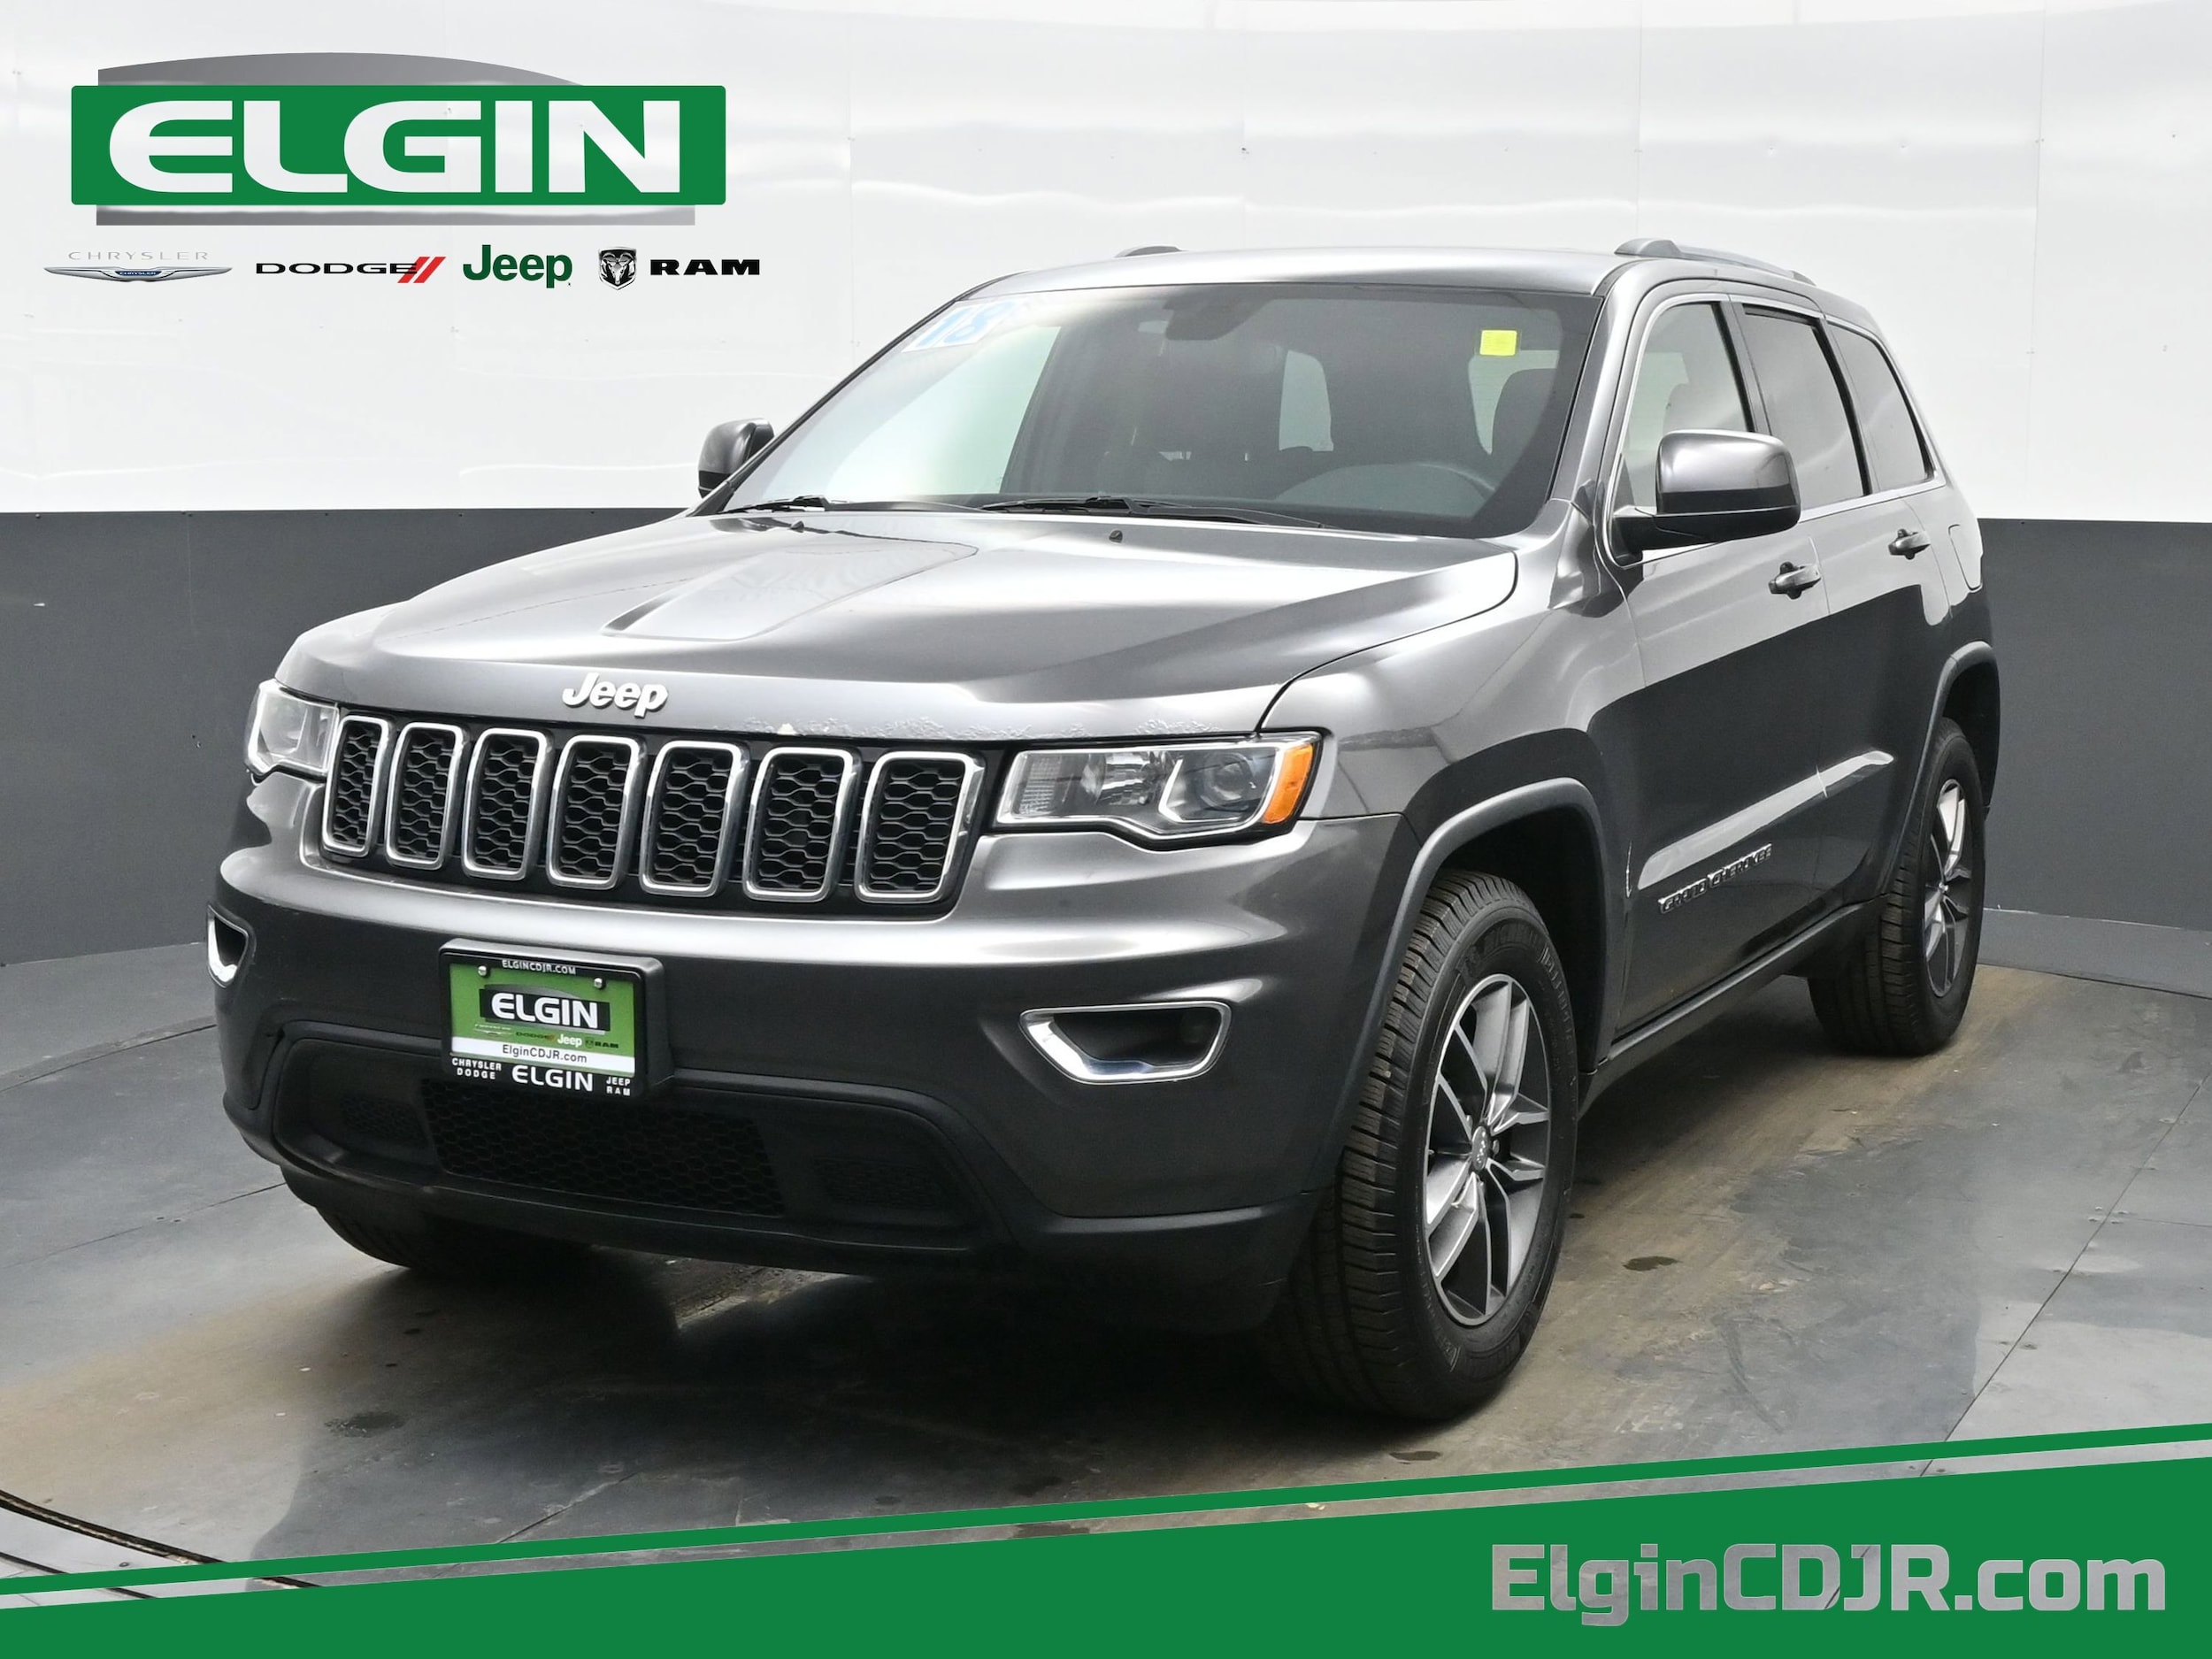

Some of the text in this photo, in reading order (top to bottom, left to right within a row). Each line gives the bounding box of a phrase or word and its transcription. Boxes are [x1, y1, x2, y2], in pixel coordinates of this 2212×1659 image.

[562, 672, 669, 719] Jeep
[502, 959, 576, 974] ELGINCDJR.COM
[491, 993, 598, 1029] ELGIN
[502, 1044, 588, 1064] ElginCDJR.com
[557, 1033, 583, 1048] Jeep
[452, 1057, 631, 1092] CHRYSLER ELGIN JEEP
[457, 1068, 631, 1096] DODGE RAM
